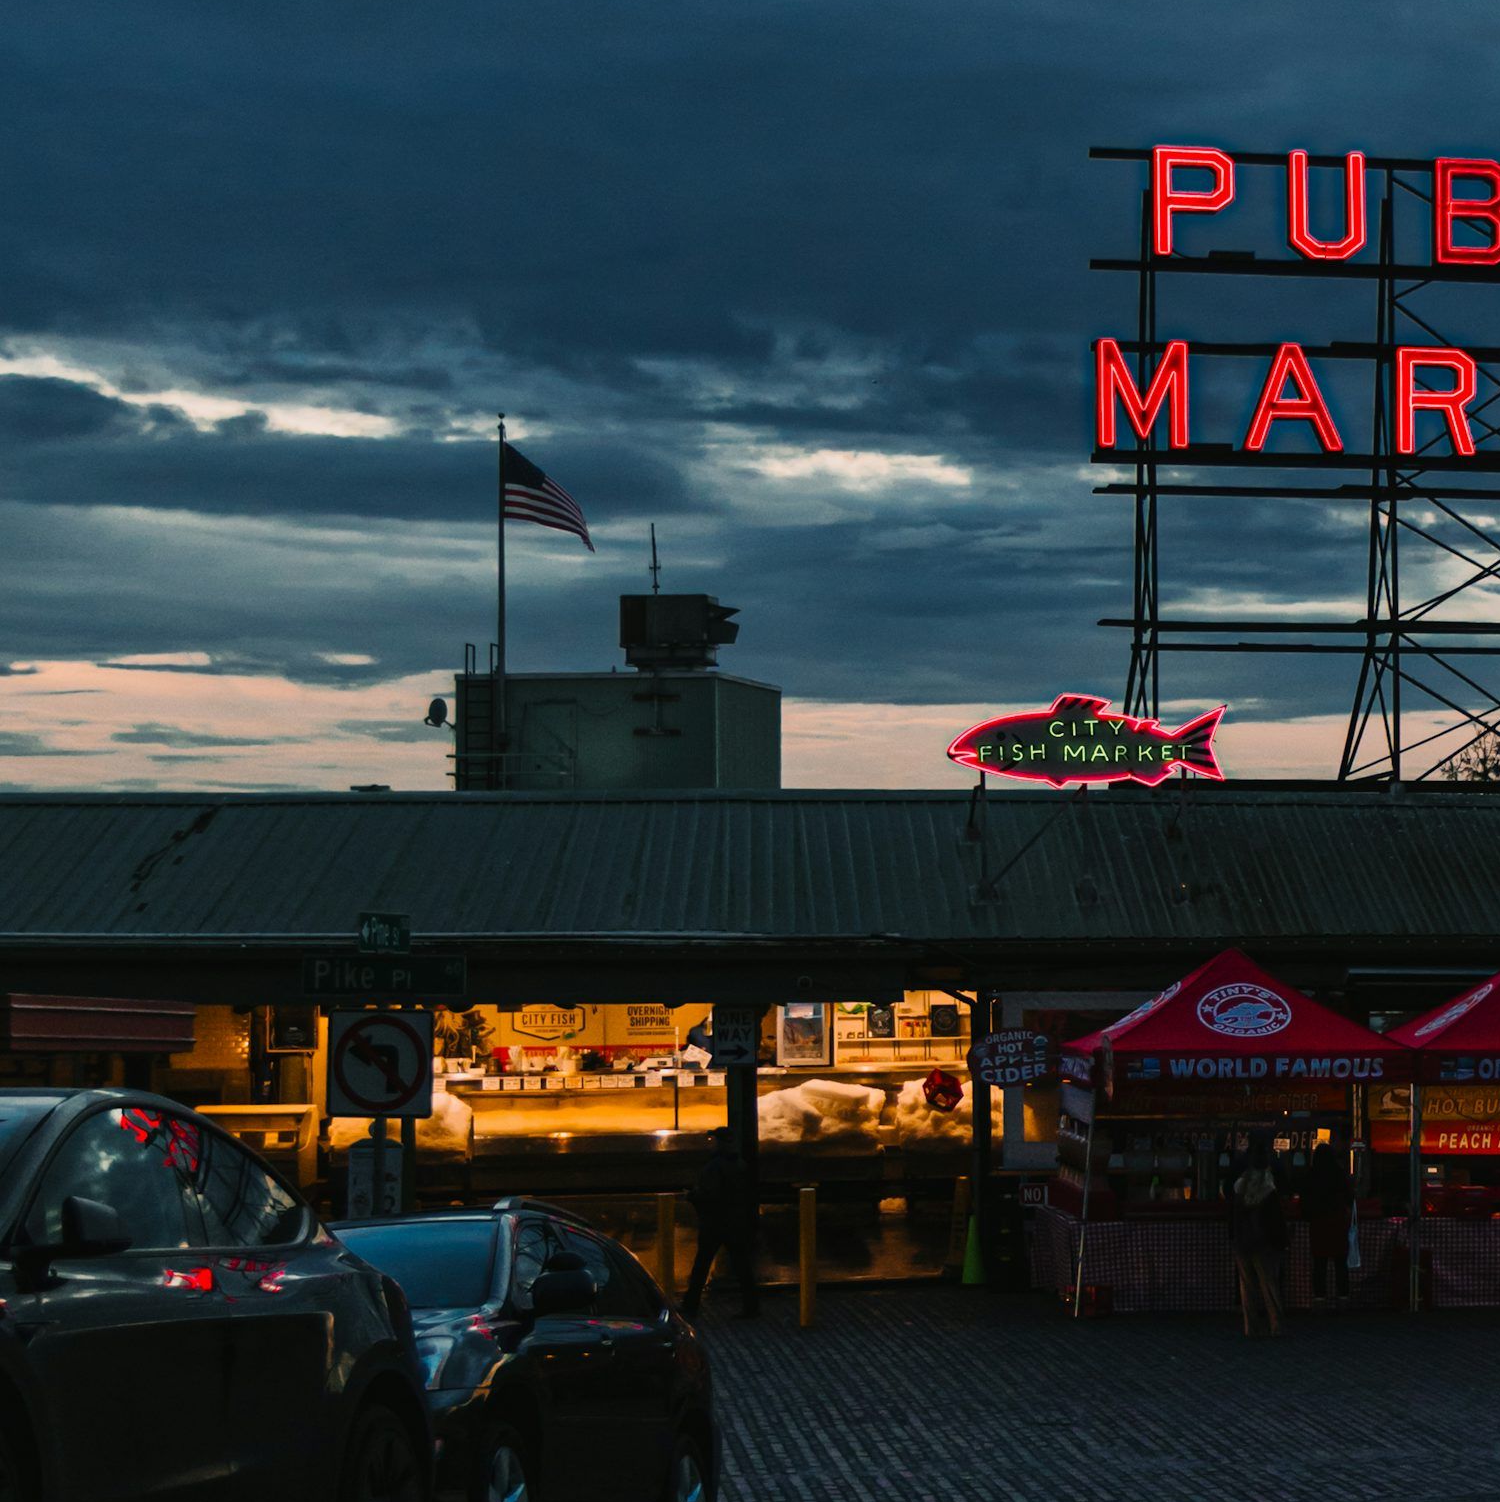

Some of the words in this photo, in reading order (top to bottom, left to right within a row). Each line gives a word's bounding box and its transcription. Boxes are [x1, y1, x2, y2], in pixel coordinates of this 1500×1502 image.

[1049, 719, 1125, 738] CITY
[978, 743, 1046, 762] FISH
[1063, 744, 1193, 762] MARKET
[313, 960, 376, 989] Pike
[391, 969, 412, 989] Pl
[1209, 986, 1272, 1001] TINY'S
[627, 1006, 675, 1016] OVERNIGHT
[719, 1011, 751, 1026] ONE
[521, 1014, 547, 1025] CITY
[551, 1013, 576, 1025] FISH
[629, 1016, 671, 1027] SHIPPING
[718, 1027, 751, 1042] WAY
[1213, 1021, 1280, 1035] ORGANIC
[985, 1030, 1034, 1045] ORGANIC
[997, 1042, 1024, 1054] HOT
[980, 1063, 1048, 1083] CIDER
[1169, 1057, 1268, 1079] WORLD
[1275, 1057, 1384, 1078] FAMOUS
[1277, 1092, 1319, 1110] CIDER
[1427, 1099, 1466, 1114] HOT
[1438, 1132, 1492, 1149] PEACH
[1023, 1187, 1042, 1202] NO
